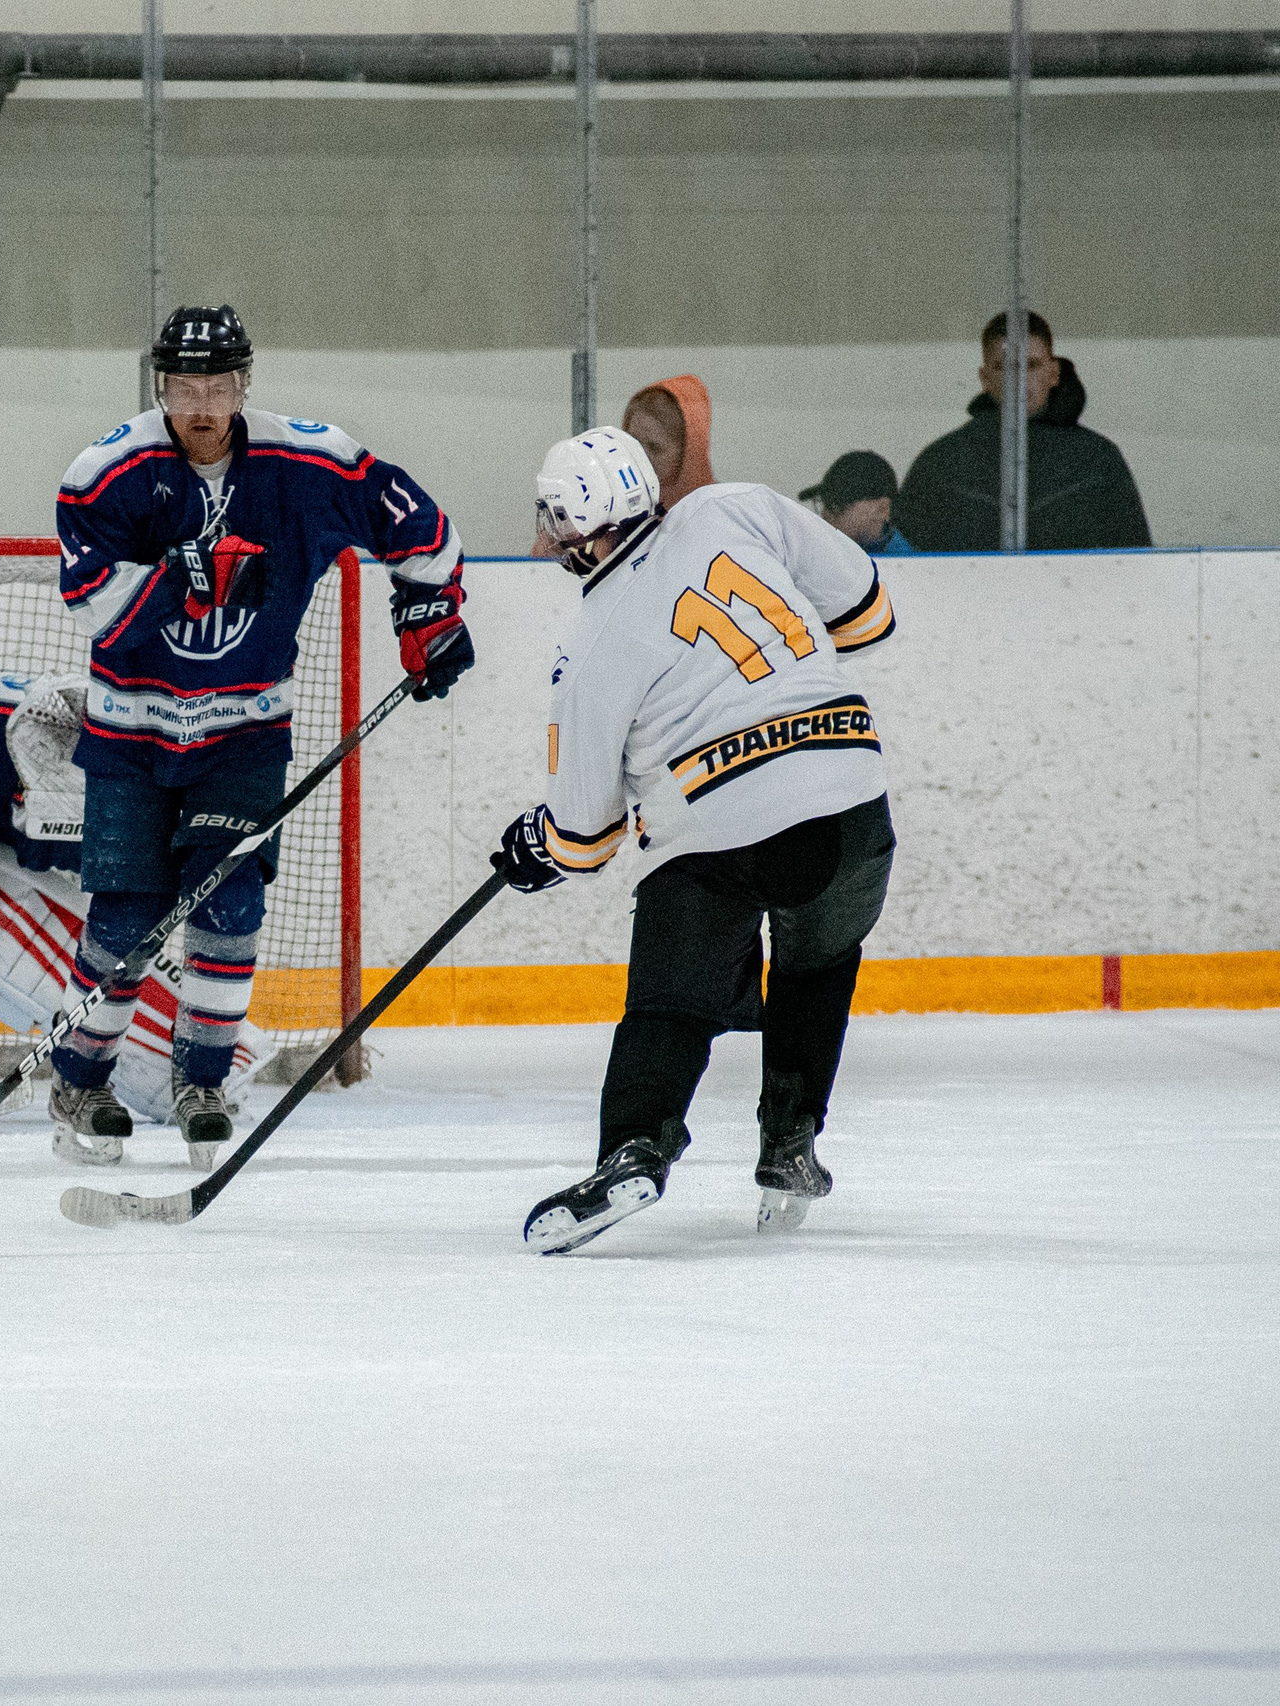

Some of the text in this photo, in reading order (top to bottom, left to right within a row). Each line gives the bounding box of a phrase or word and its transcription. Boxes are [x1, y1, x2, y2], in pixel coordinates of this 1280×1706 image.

[181, 321, 211, 342] 11
[380, 477, 419, 526] 11
[618, 465, 639, 490] 11
[670, 550, 819, 686] 11
[698, 709, 876, 775] ТРАНСНЕФ
